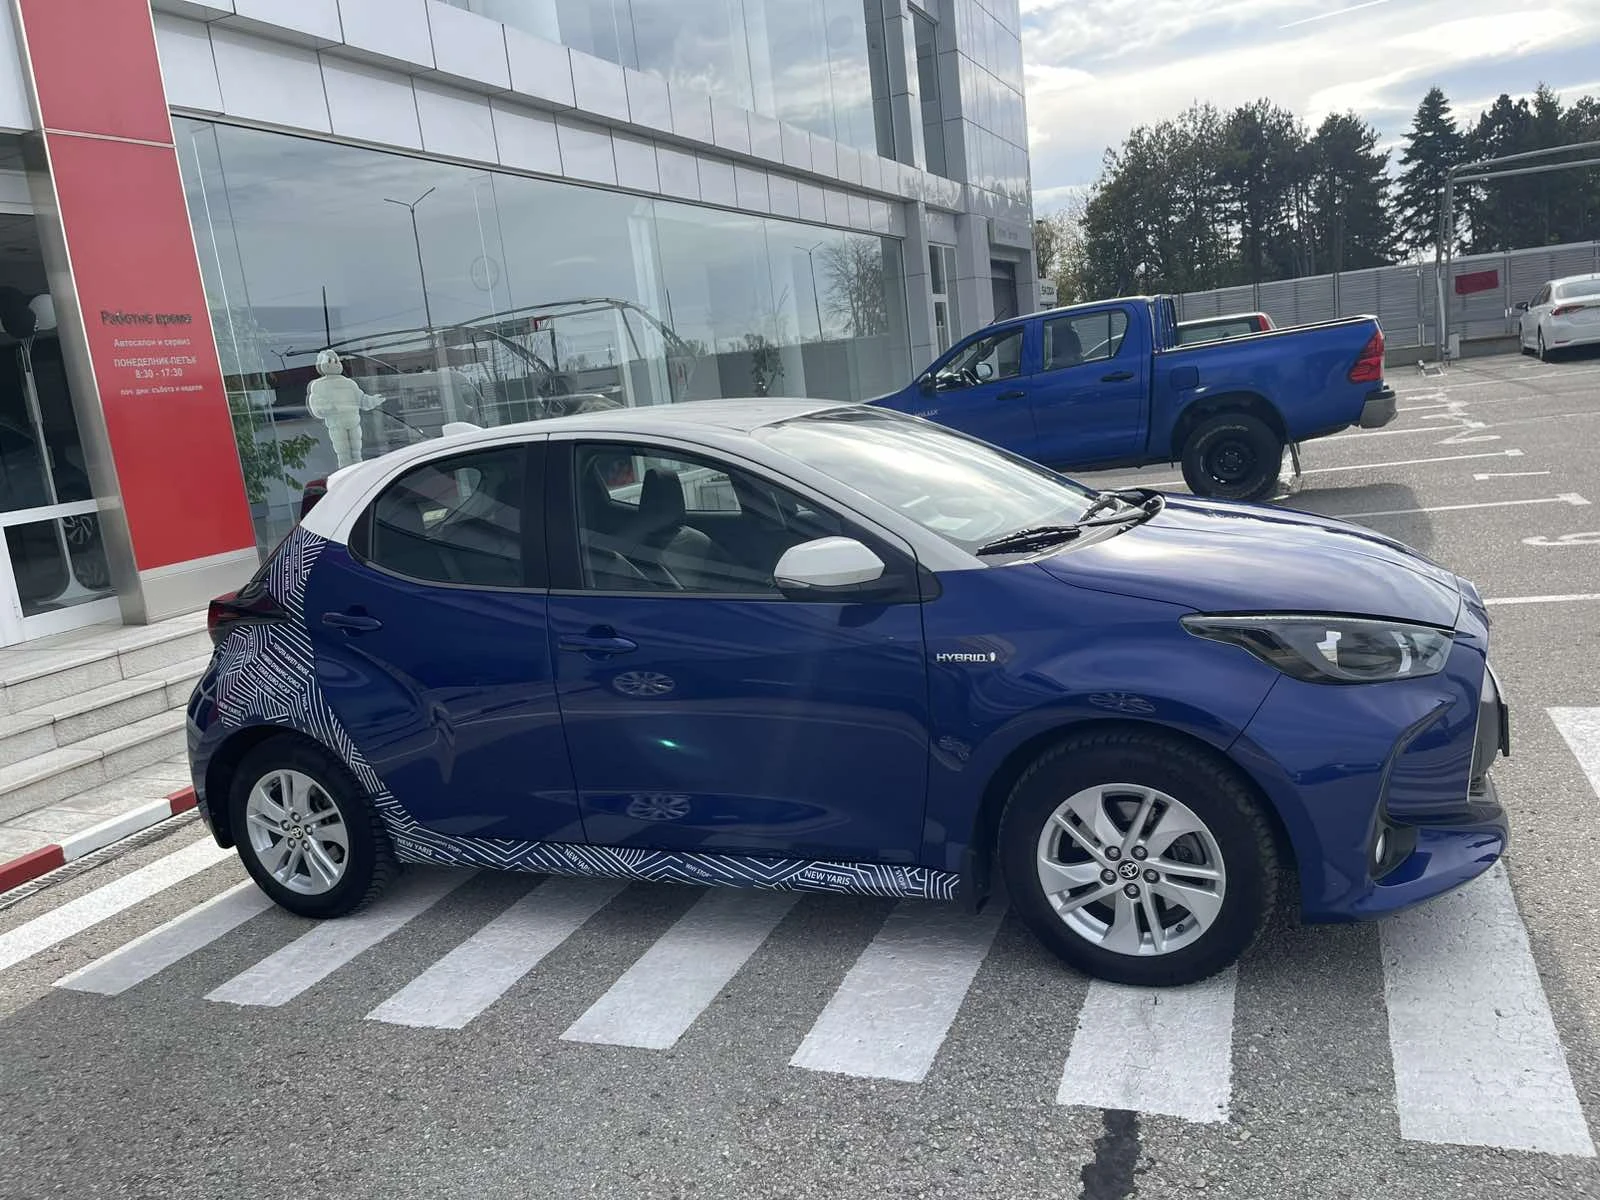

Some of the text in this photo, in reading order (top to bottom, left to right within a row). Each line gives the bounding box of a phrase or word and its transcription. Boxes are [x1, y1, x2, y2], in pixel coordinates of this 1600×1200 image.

[101, 311, 192, 325] Работно време
[114, 339, 155, 348] Автосалон
[164, 338, 191, 347] сервиз
[135, 369, 153, 379] 8:30
[161, 368, 183, 377] 17:30
[936, 653, 985, 662] HYBRID
[414, 844, 433, 856] YARIS
[564, 848, 580, 861] NEW
[804, 870, 851, 886] NEW YARIS
